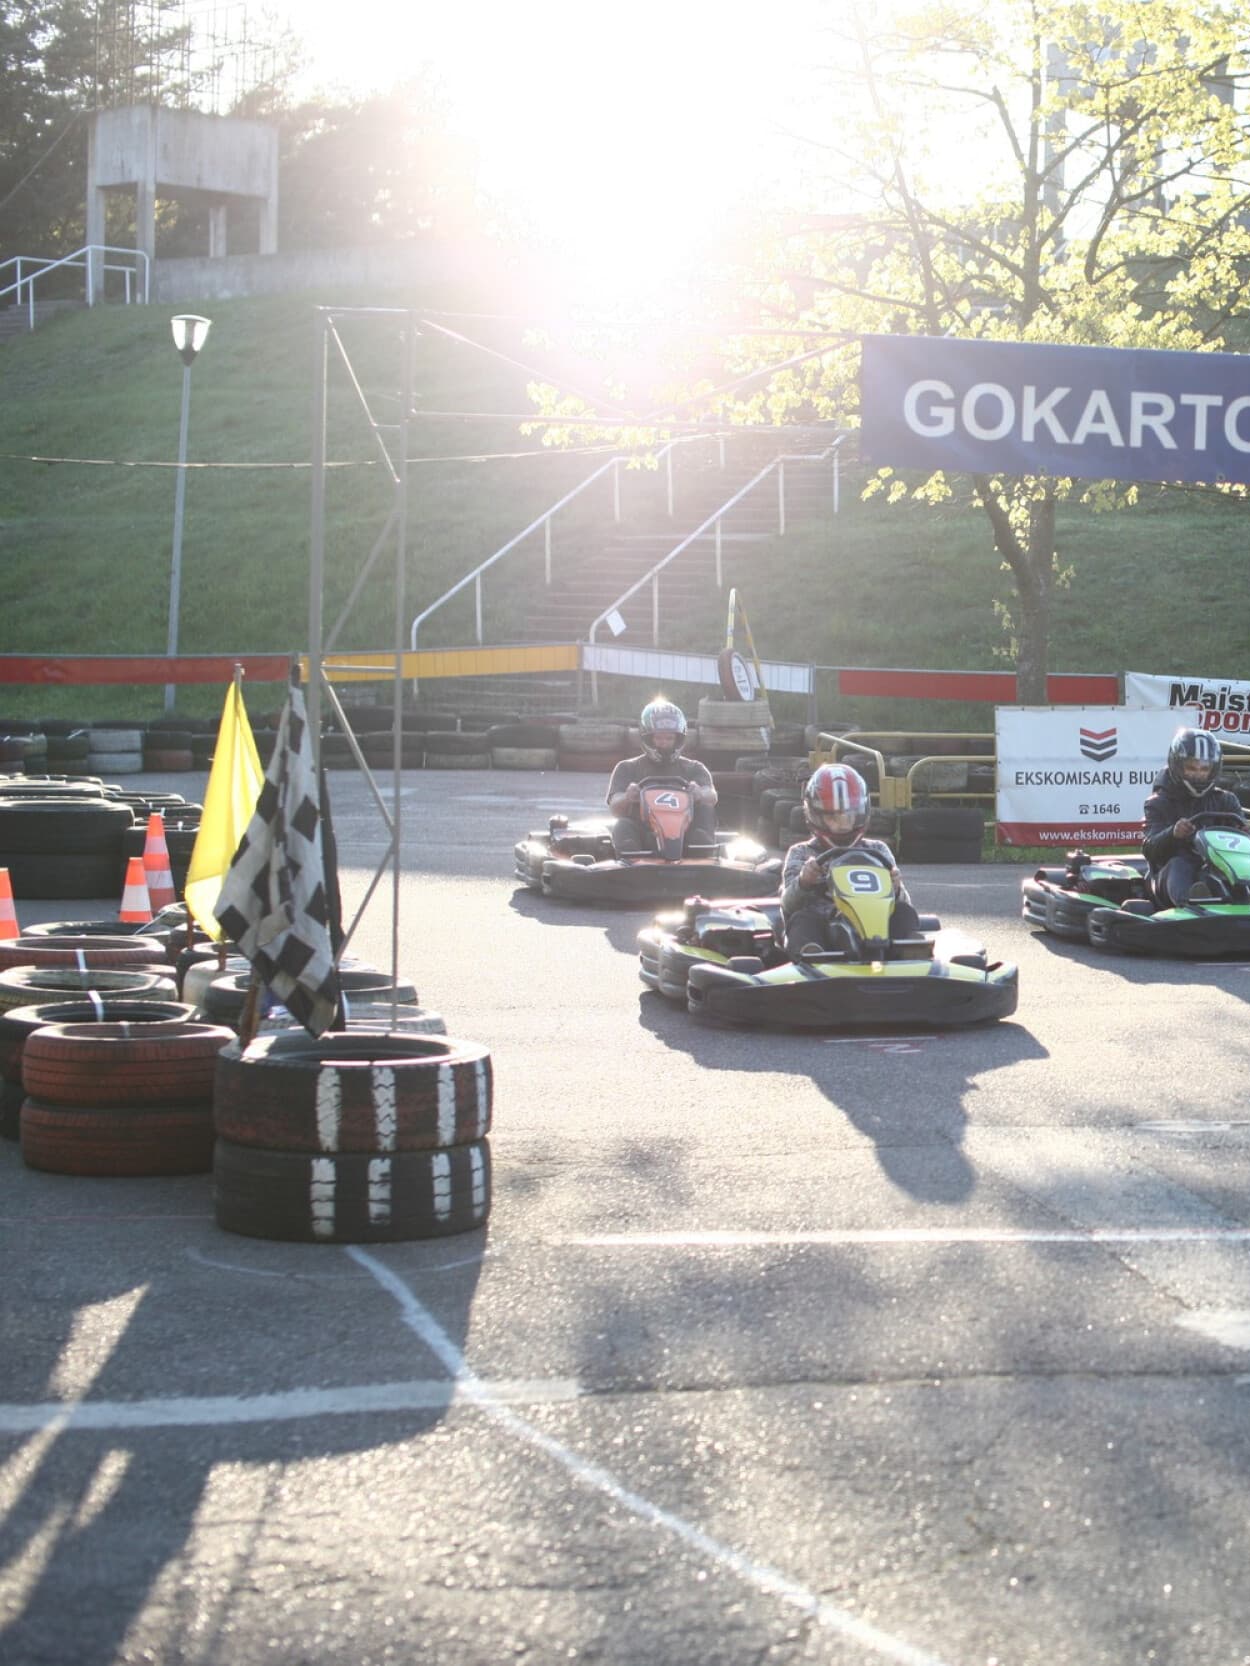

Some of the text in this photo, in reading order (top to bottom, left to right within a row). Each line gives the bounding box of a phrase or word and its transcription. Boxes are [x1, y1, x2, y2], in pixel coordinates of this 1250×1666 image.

[1015, 770, 1158, 788] EKSKOMISARŲ BIU
[655, 792, 680, 809] 4
[1093, 804, 1121, 815] 1646
[1216, 834, 1242, 850] 7
[848, 869, 881, 893] 9
